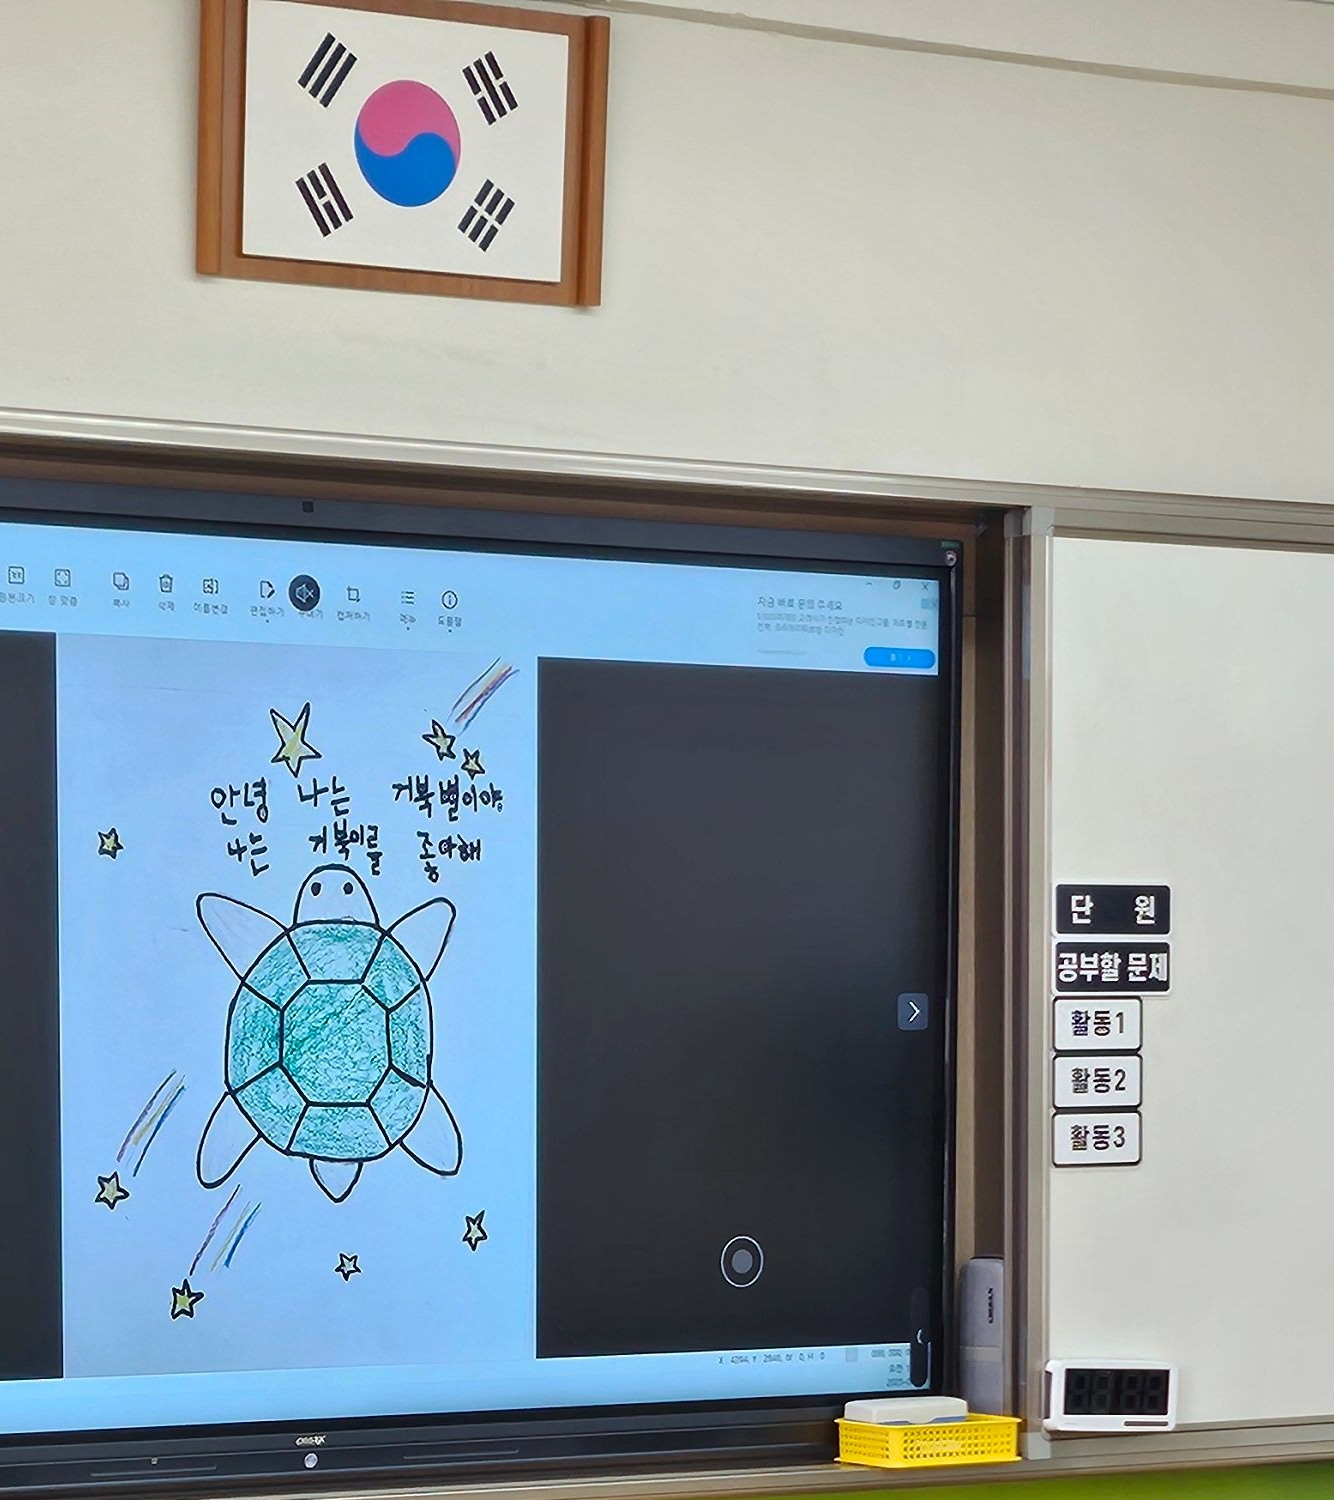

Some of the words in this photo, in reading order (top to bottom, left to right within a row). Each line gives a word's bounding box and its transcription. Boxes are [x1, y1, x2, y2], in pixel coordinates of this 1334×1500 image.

[211, 777, 269, 825] 안녕
[298, 776, 351, 817] 나는
[227, 832, 270, 877] 나는
[308, 818, 384, 876] 거북이를
[417, 831, 483, 884] 좋아해
[1070, 894, 1095, 925] 단
[1134, 895, 1156, 925] 원
[1058, 952, 1122, 983] 공부할
[1127, 952, 1168, 983] 문제
[1071, 1009, 1125, 1037] 활동1
[1071, 1067, 1126, 1095] 활동2
[1070, 1124, 1126, 1152] 활동3
